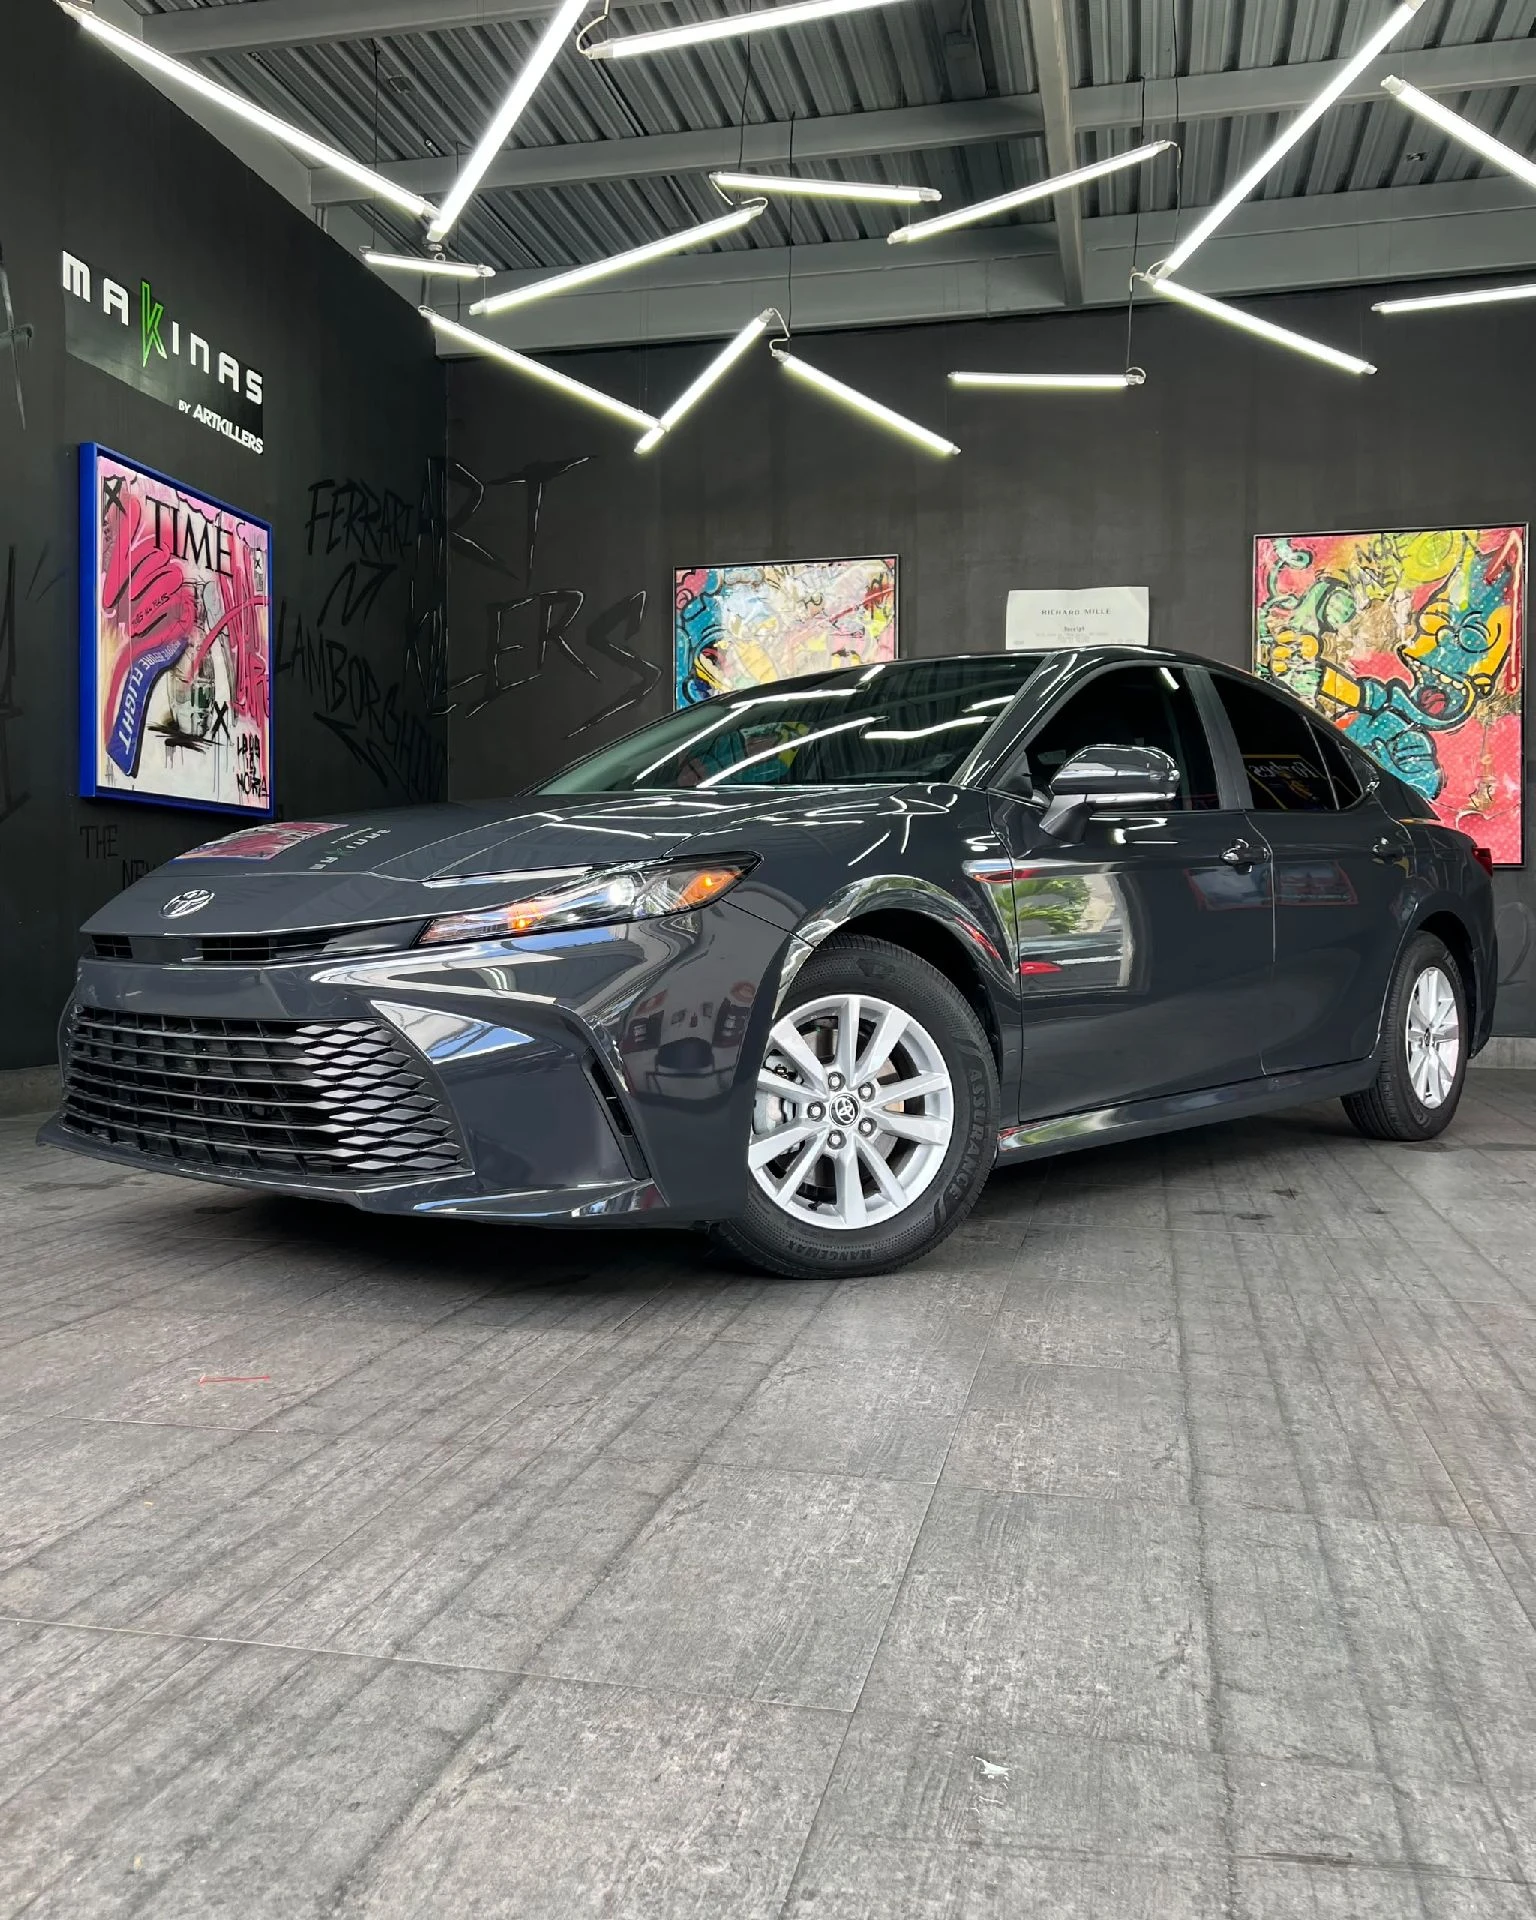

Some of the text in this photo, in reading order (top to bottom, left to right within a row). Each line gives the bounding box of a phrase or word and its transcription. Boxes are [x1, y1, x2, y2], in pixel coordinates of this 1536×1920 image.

[178, 400, 263, 454] BY ARTKILLERS
[146, 495, 234, 578] TIME
[305, 478, 414, 562] FERRARI
[118, 668, 144, 755] FLIGHT
[80, 824, 120, 860] THE
